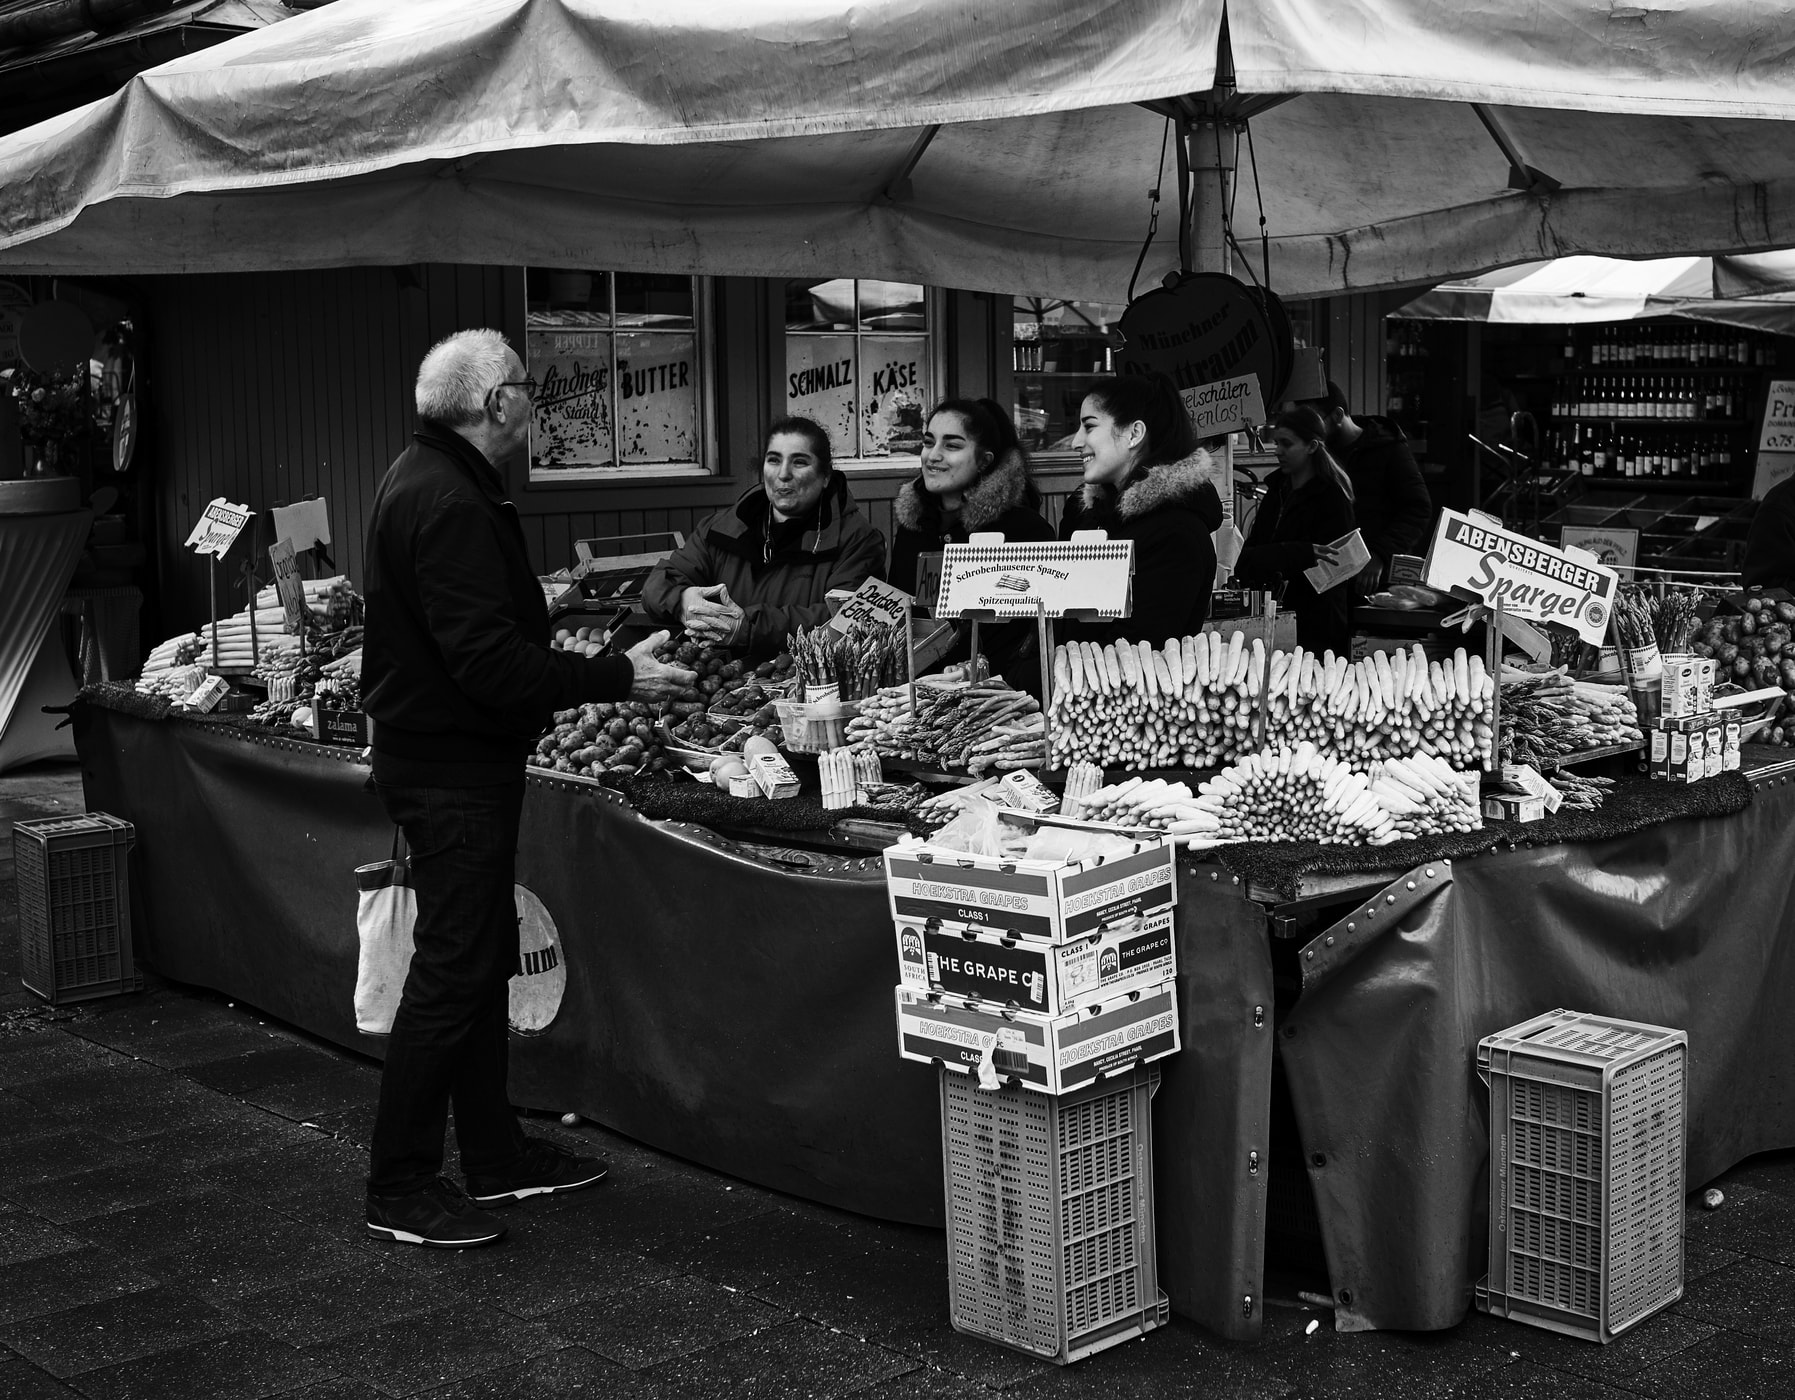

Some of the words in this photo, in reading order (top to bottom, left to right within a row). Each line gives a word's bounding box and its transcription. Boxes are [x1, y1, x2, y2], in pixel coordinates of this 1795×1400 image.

[1138, 302, 1230, 350] Münchner
[623, 361, 689, 399] BUTTER
[788, 359, 852, 399] SCHMALZ
[873, 361, 917, 396] KÄSE
[1182, 380, 1251, 410] elschälen
[1455, 524, 1600, 592] ABENSBERGER
[956, 564, 1035, 583] Schrobenhausener
[1036, 564, 1070, 581] Spargel
[1467, 551, 1592, 618] Spargel
[978, 596, 1043, 607] Spitzenqualität
[327, 713, 358, 732] zalama
[912, 882, 977, 902] HOEKSTRA
[979, 891, 1029, 910] GRAPES
[1064, 883, 1125, 914] HOEKSTRA
[1127, 867, 1172, 893] GRAPES
[957, 908, 983, 921] CLASS
[984, 912, 989, 922] 1
[1143, 916, 1170, 931] GRAPES
[1061, 944, 1083, 958] CLASS
[1121, 949, 1135, 959] THE
[1136, 941, 1159, 954] GRAPE
[904, 963, 925, 974] SOUTH
[904, 972, 926, 982] AFRICA
[936, 954, 960, 973] HE
[963, 961, 1018, 985] GRAPE
[1021, 972, 1032, 987] C
[1162, 967, 1173, 976] 120
[919, 1020, 979, 1046] HOEKSTRA
[1059, 1031, 1124, 1066] HOEKSTRA
[1127, 1014, 1173, 1041] GRAPES
